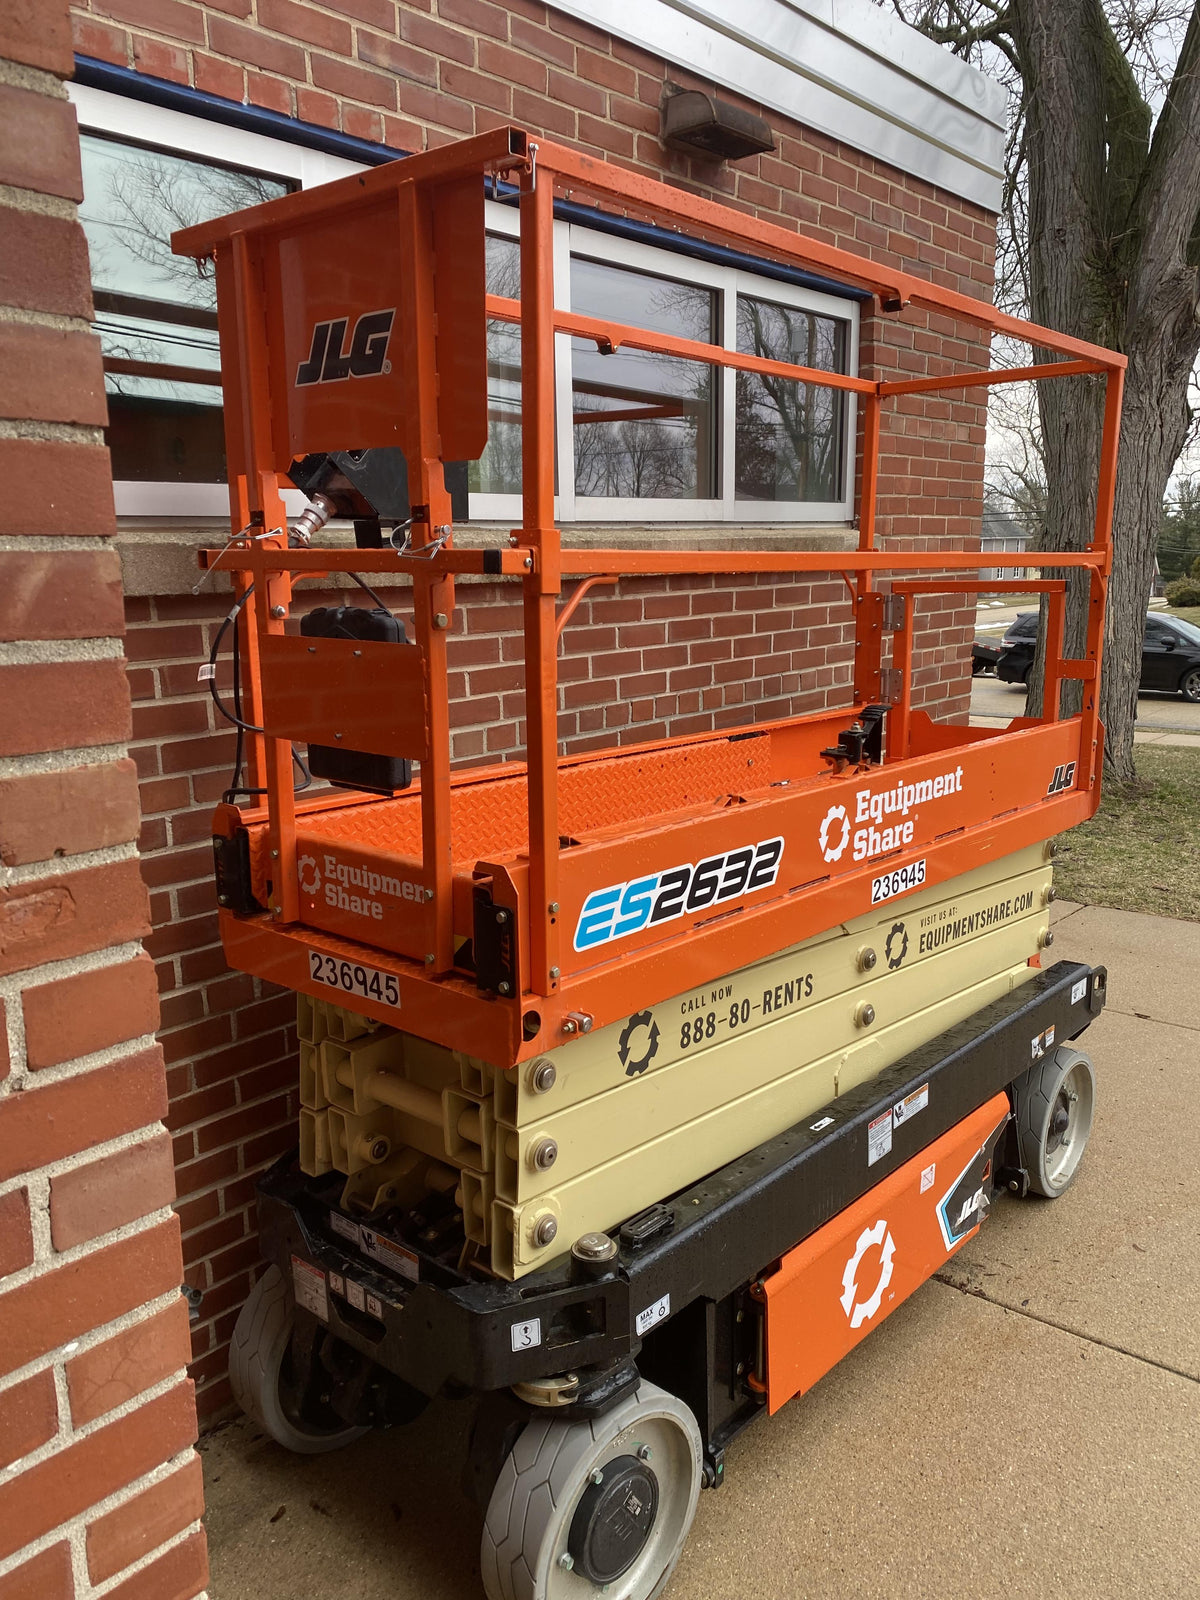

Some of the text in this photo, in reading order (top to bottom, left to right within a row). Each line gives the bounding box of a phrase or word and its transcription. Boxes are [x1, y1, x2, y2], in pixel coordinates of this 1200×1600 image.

[295, 307, 397, 388] JLG
[855, 765, 963, 824] Equipment
[1047, 761, 1077, 795] JLG
[852, 820, 914, 861] Share
[324, 855, 425, 904] Equipmen
[324, 883, 383, 920] Share
[574, 836, 785, 952] ES2632
[872, 860, 925, 903] 236945
[919, 890, 1034, 954] EQUIPMENTSHARE.COM
[920, 914, 937, 928] VISIT
[938, 910, 947, 921] US
[311, 953, 399, 1006] 236945
[681, 984, 733, 1015] CALL NOW
[680, 973, 814, 1049] 888-80-RENTS
[640, 1308, 654, 1322] MAX
